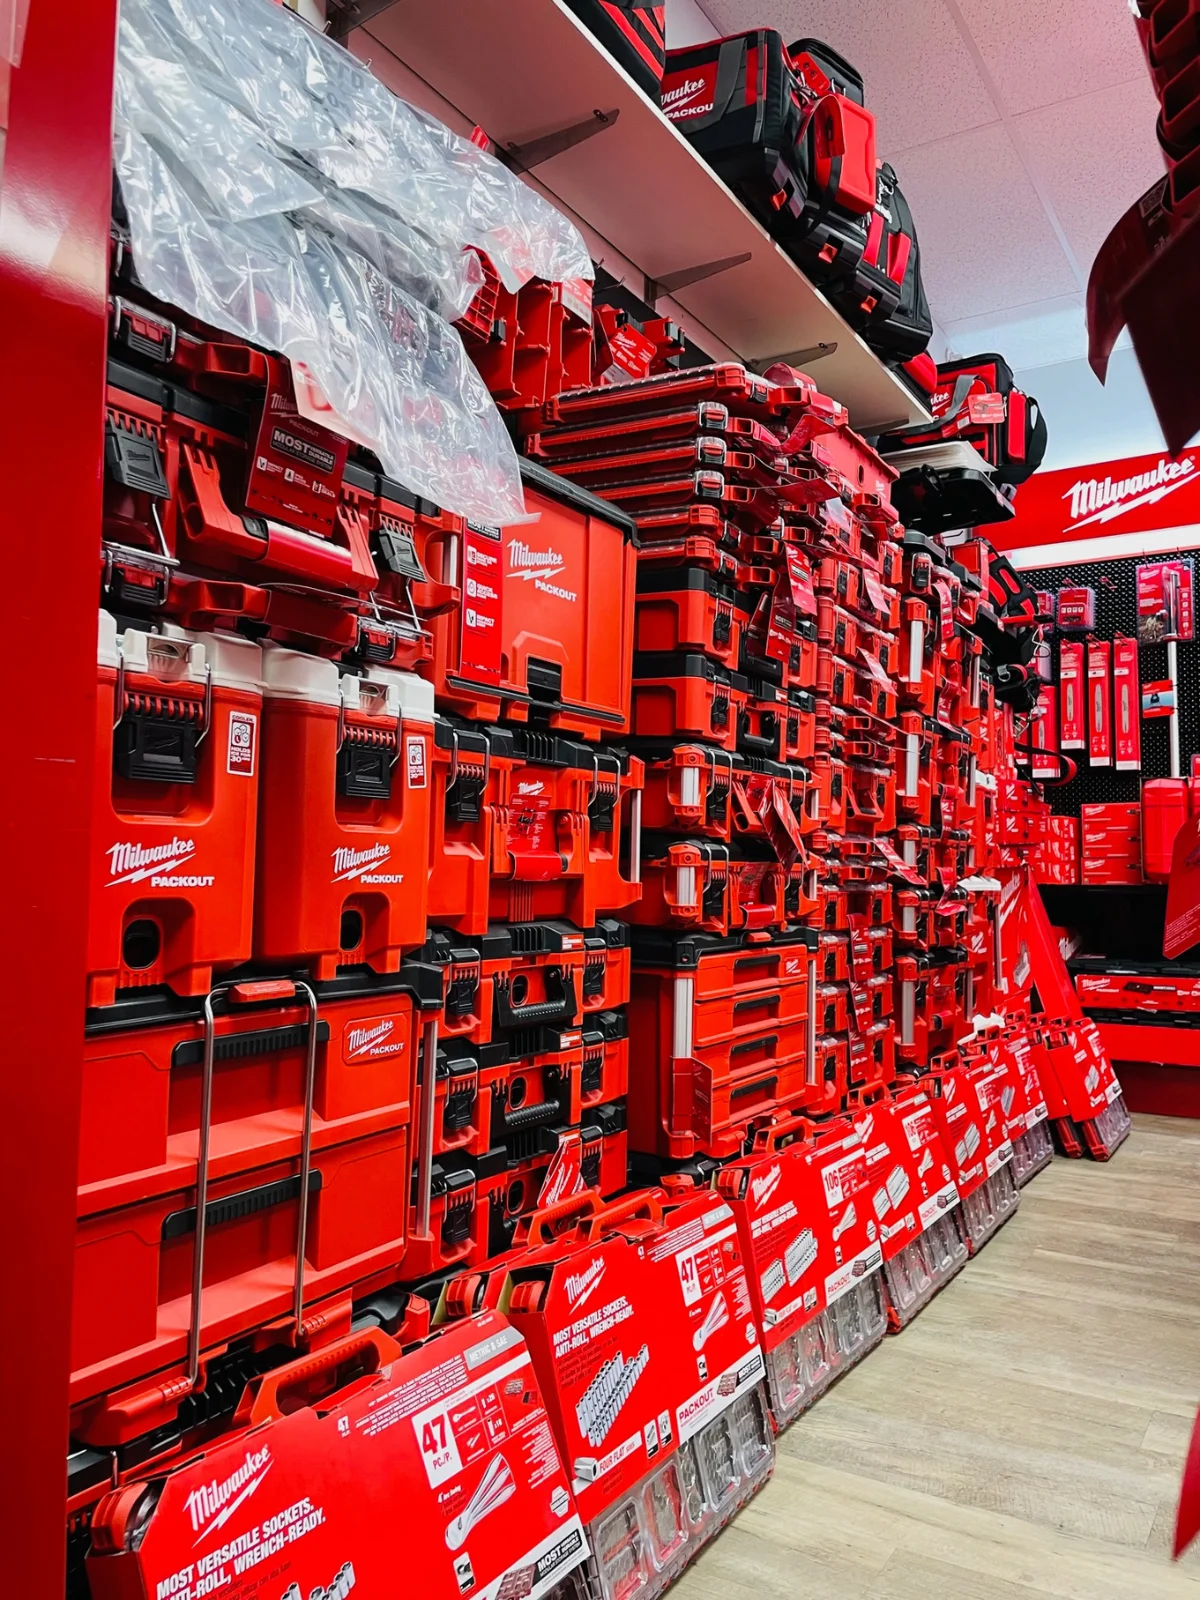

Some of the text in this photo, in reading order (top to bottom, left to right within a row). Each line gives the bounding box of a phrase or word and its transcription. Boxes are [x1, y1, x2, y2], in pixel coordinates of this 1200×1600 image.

[665, 103, 714, 119] PACKOU
[274, 430, 311, 454] MOST
[1061, 457, 1196, 518] Milwaukee
[506, 539, 564, 567] Milwaukee
[534, 579, 577, 602] PACKOUT
[232, 714, 253, 722] COOLER
[230, 746, 251, 754] HOLDS
[105, 836, 195, 875] Milwaukee
[331, 842, 390, 874] Milwaukee
[151, 875, 215, 887] PACKOUT
[360, 874, 403, 883] PACKOUT
[347, 1019, 394, 1051] Milwaukee
[370, 1042, 404, 1056] PACKOUT
[824, 1169, 839, 1192] 106
[563, 1256, 605, 1304] Milwaukee
[681, 1257, 694, 1283] 47
[553, 1326, 571, 1346] MOST
[571, 1308, 602, 1335] VERSATILE
[469, 1344, 490, 1362] METRIC
[496, 1335, 508, 1348] SAE
[679, 1388, 714, 1421] PACKOUT
[422, 1415, 447, 1455] 47
[183, 1449, 271, 1531] Milwaukee
[156, 1563, 194, 1600] MOST
[197, 1527, 260, 1575] VERSATILE
[262, 1497, 315, 1538] SOCKETS.
[233, 1507, 327, 1575] WRENCH-READY.
[537, 1545, 561, 1573] MOST
